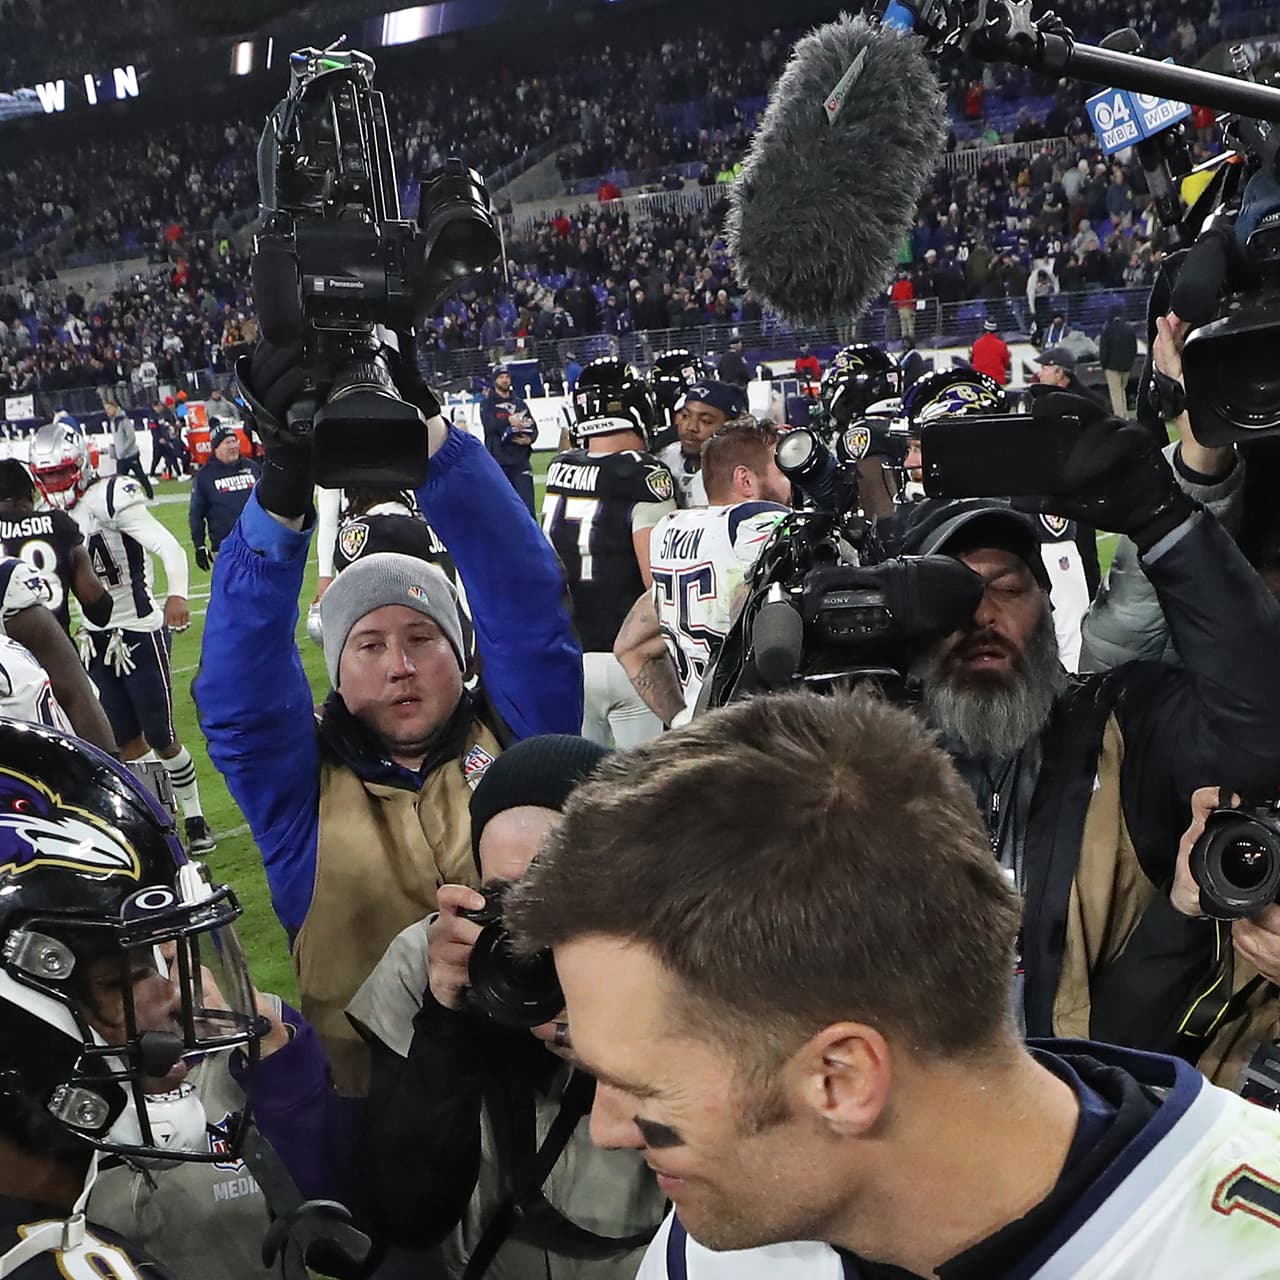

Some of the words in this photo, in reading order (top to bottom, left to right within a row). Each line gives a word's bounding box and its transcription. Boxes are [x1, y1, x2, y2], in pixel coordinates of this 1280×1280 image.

[36, 65, 140, 114] WIN
[1113, 93, 1131, 123] 4
[1102, 120, 1139, 148] WBZ
[329, 279, 365, 289] Panasonic
[213, 473, 257, 492] PATRIOTS
